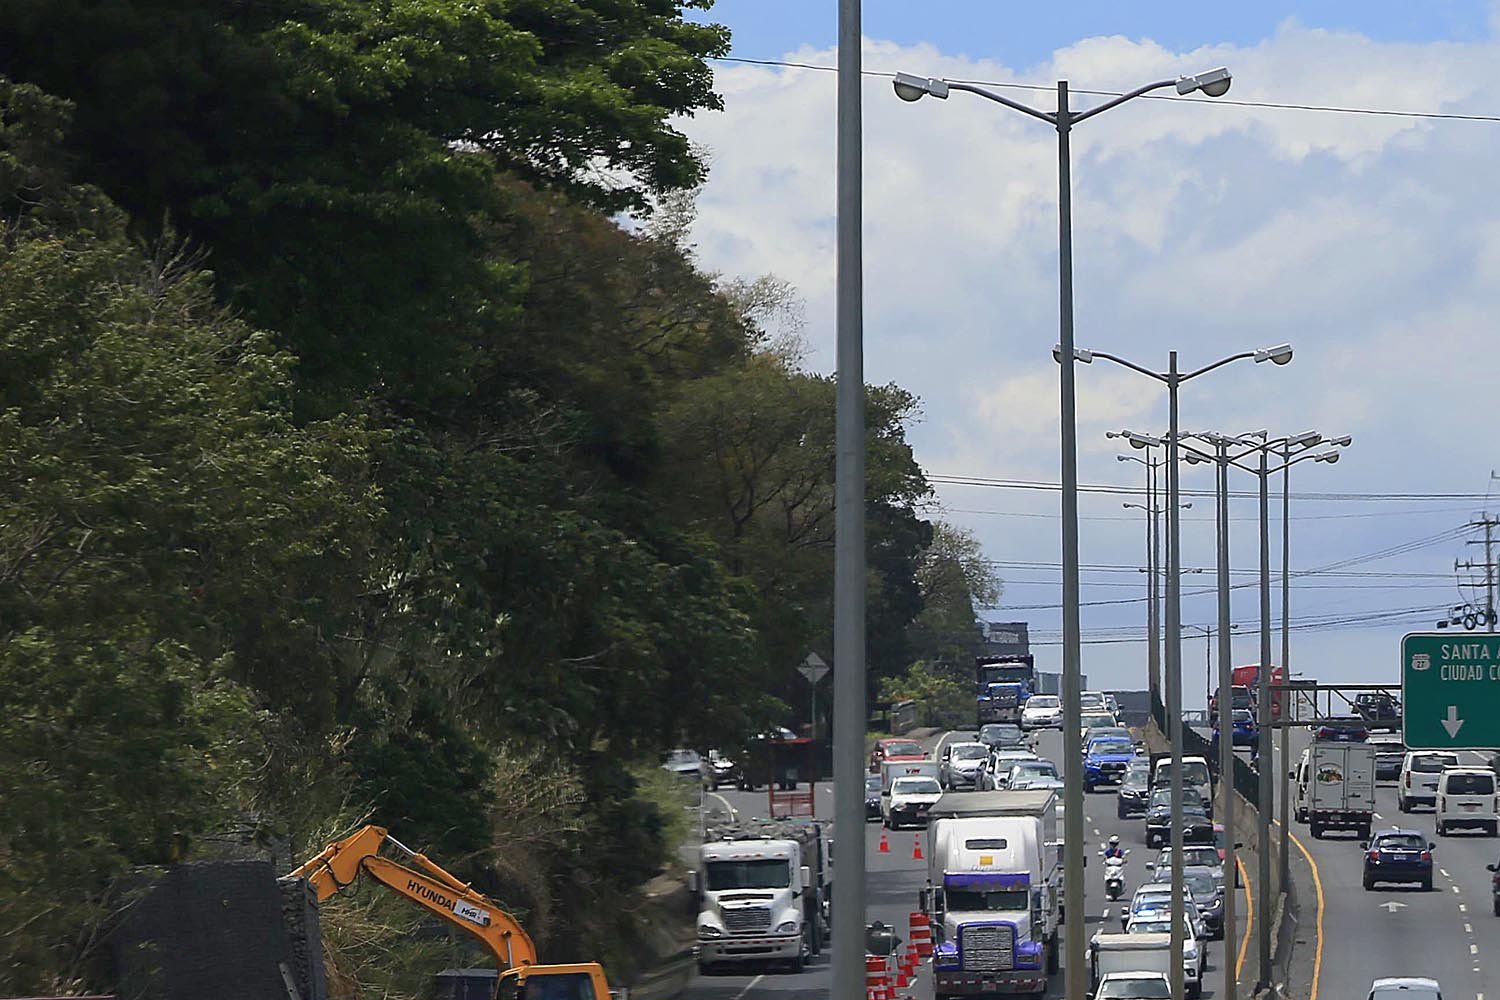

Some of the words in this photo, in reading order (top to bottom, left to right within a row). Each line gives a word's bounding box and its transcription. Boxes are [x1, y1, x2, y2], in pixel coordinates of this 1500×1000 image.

[1441, 644, 1490, 659] SANTA
[1440, 665, 1483, 680] CIUDAD
[406, 880, 457, 912] HYUNDAI
